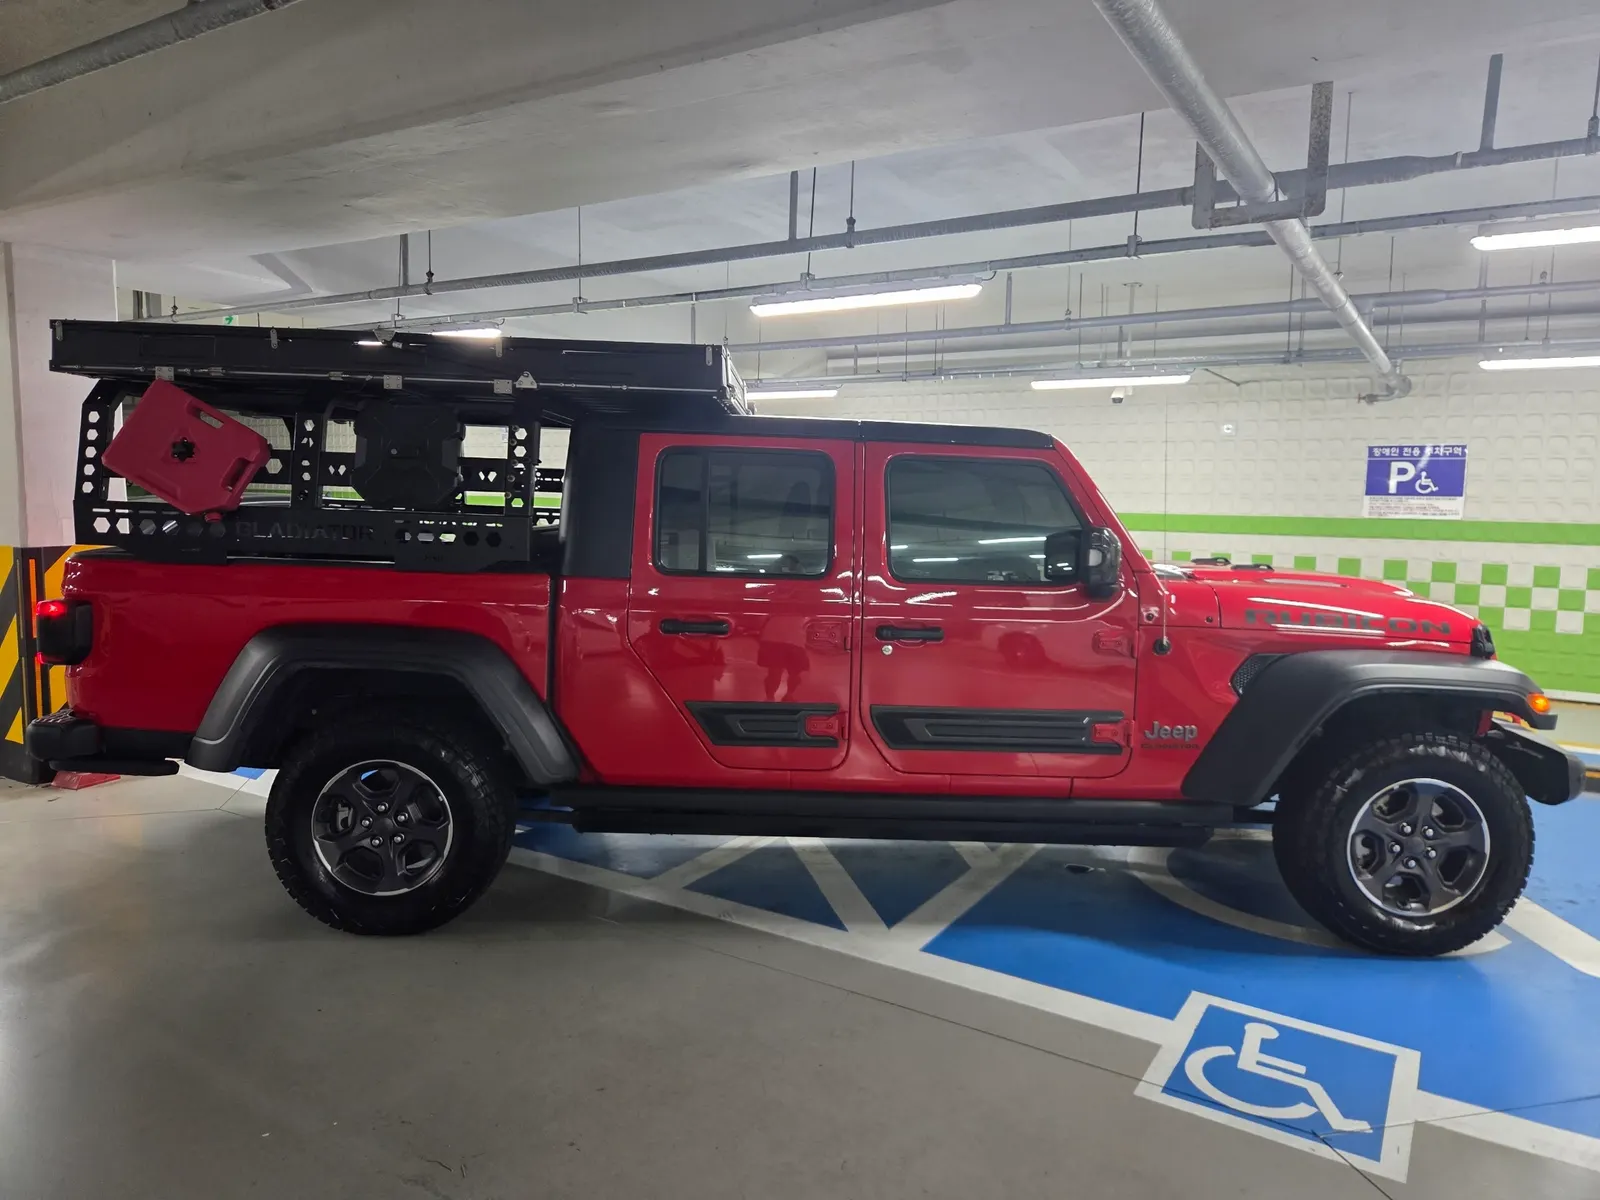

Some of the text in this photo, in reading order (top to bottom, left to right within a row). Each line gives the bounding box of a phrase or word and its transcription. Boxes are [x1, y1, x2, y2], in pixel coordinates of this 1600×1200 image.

[1372, 447, 1399, 457] 장애인
[1402, 447, 1421, 456] 전용
[1388, 461, 1416, 494] P
[235, 520, 375, 542] GLADIATOR
[1244, 608, 1450, 635] RUBICON
[1144, 720, 1198, 742] Jeep
